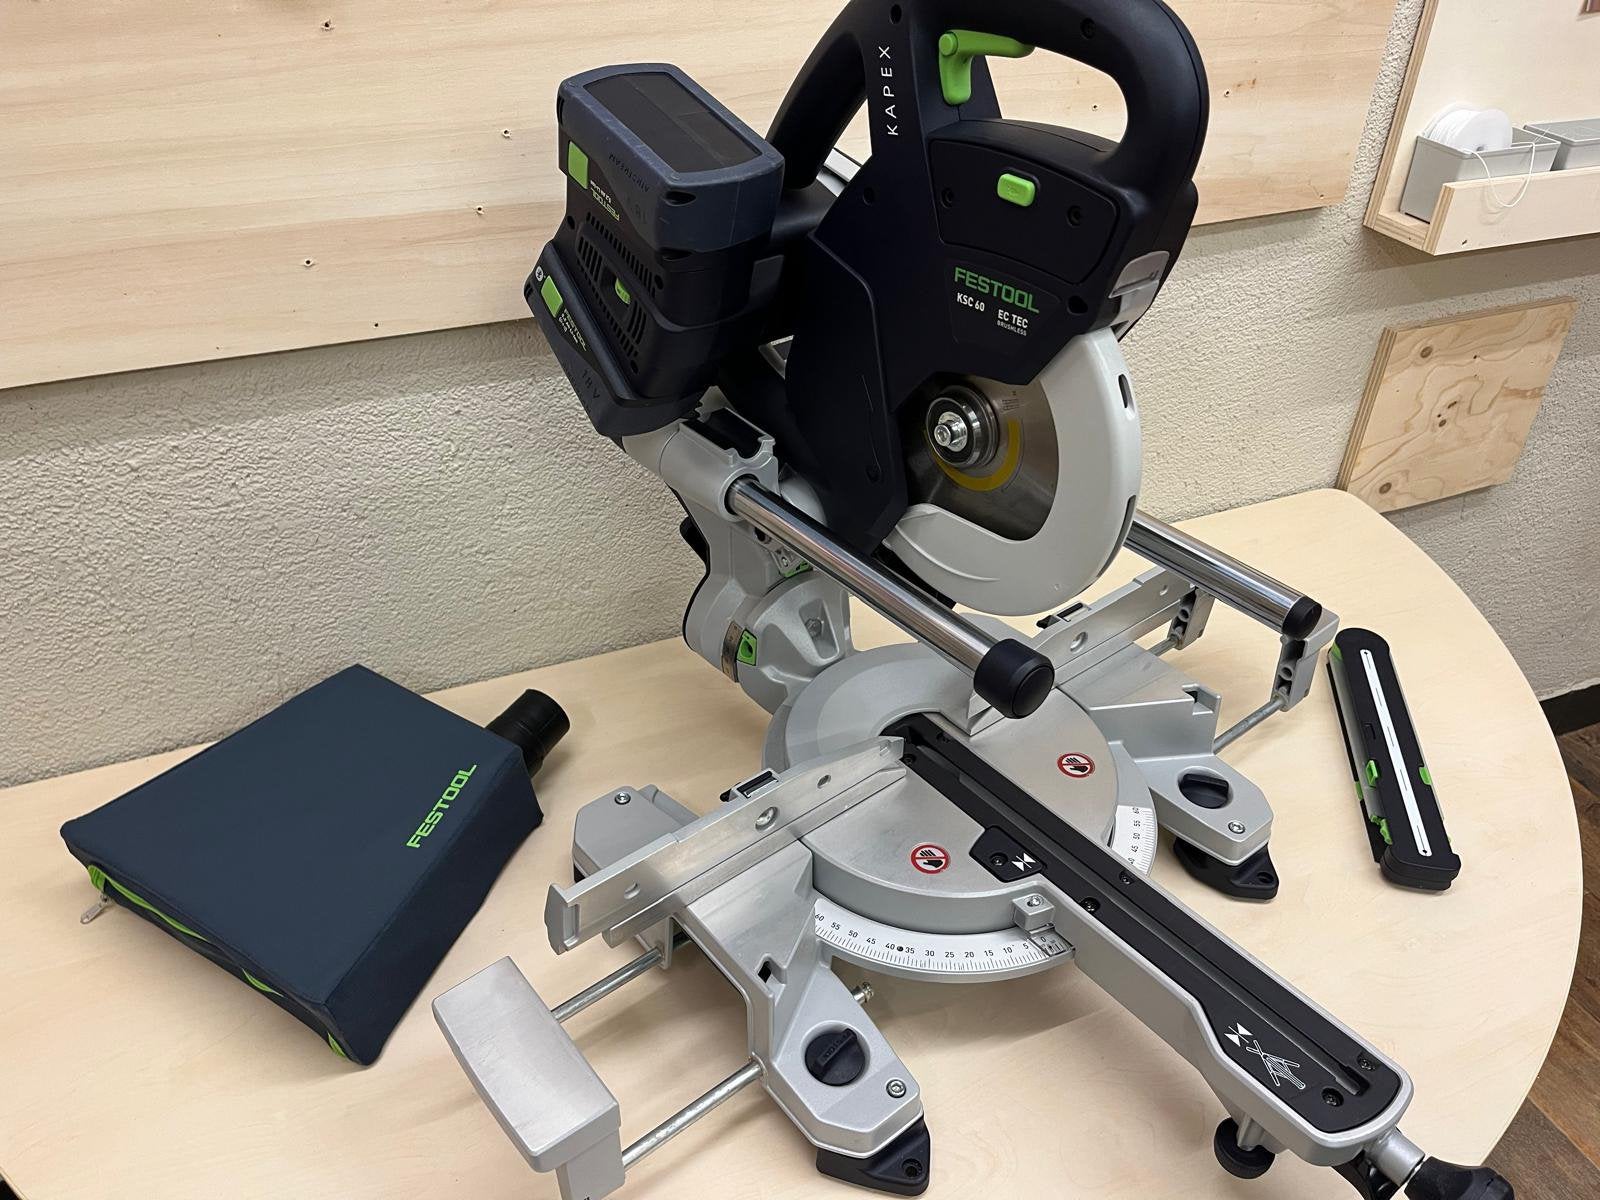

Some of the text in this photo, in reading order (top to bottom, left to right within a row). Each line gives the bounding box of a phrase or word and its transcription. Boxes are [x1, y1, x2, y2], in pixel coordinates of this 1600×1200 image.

[878, 46, 899, 136] KAPEX
[954, 266, 1040, 314] FESTOOL
[956, 292, 985, 312] KSC 60
[997, 308, 1029, 329] EC TEC
[997, 320, 1027, 336] BRUSHLESS
[406, 764, 477, 848] FESTOOL
[1132, 832, 1140, 840] 50
[1131, 844, 1139, 853] 45
[814, 914, 825, 922] 60
[830, 921, 841, 931] 55
[848, 929, 859, 938] 50
[866, 937, 877, 945] 45
[885, 943, 896, 951] 40
[904, 946, 915, 955] 35
[924, 949, 935, 957] 30
[984, 949, 994, 957] 15
[1002, 946, 1013, 955] 10
